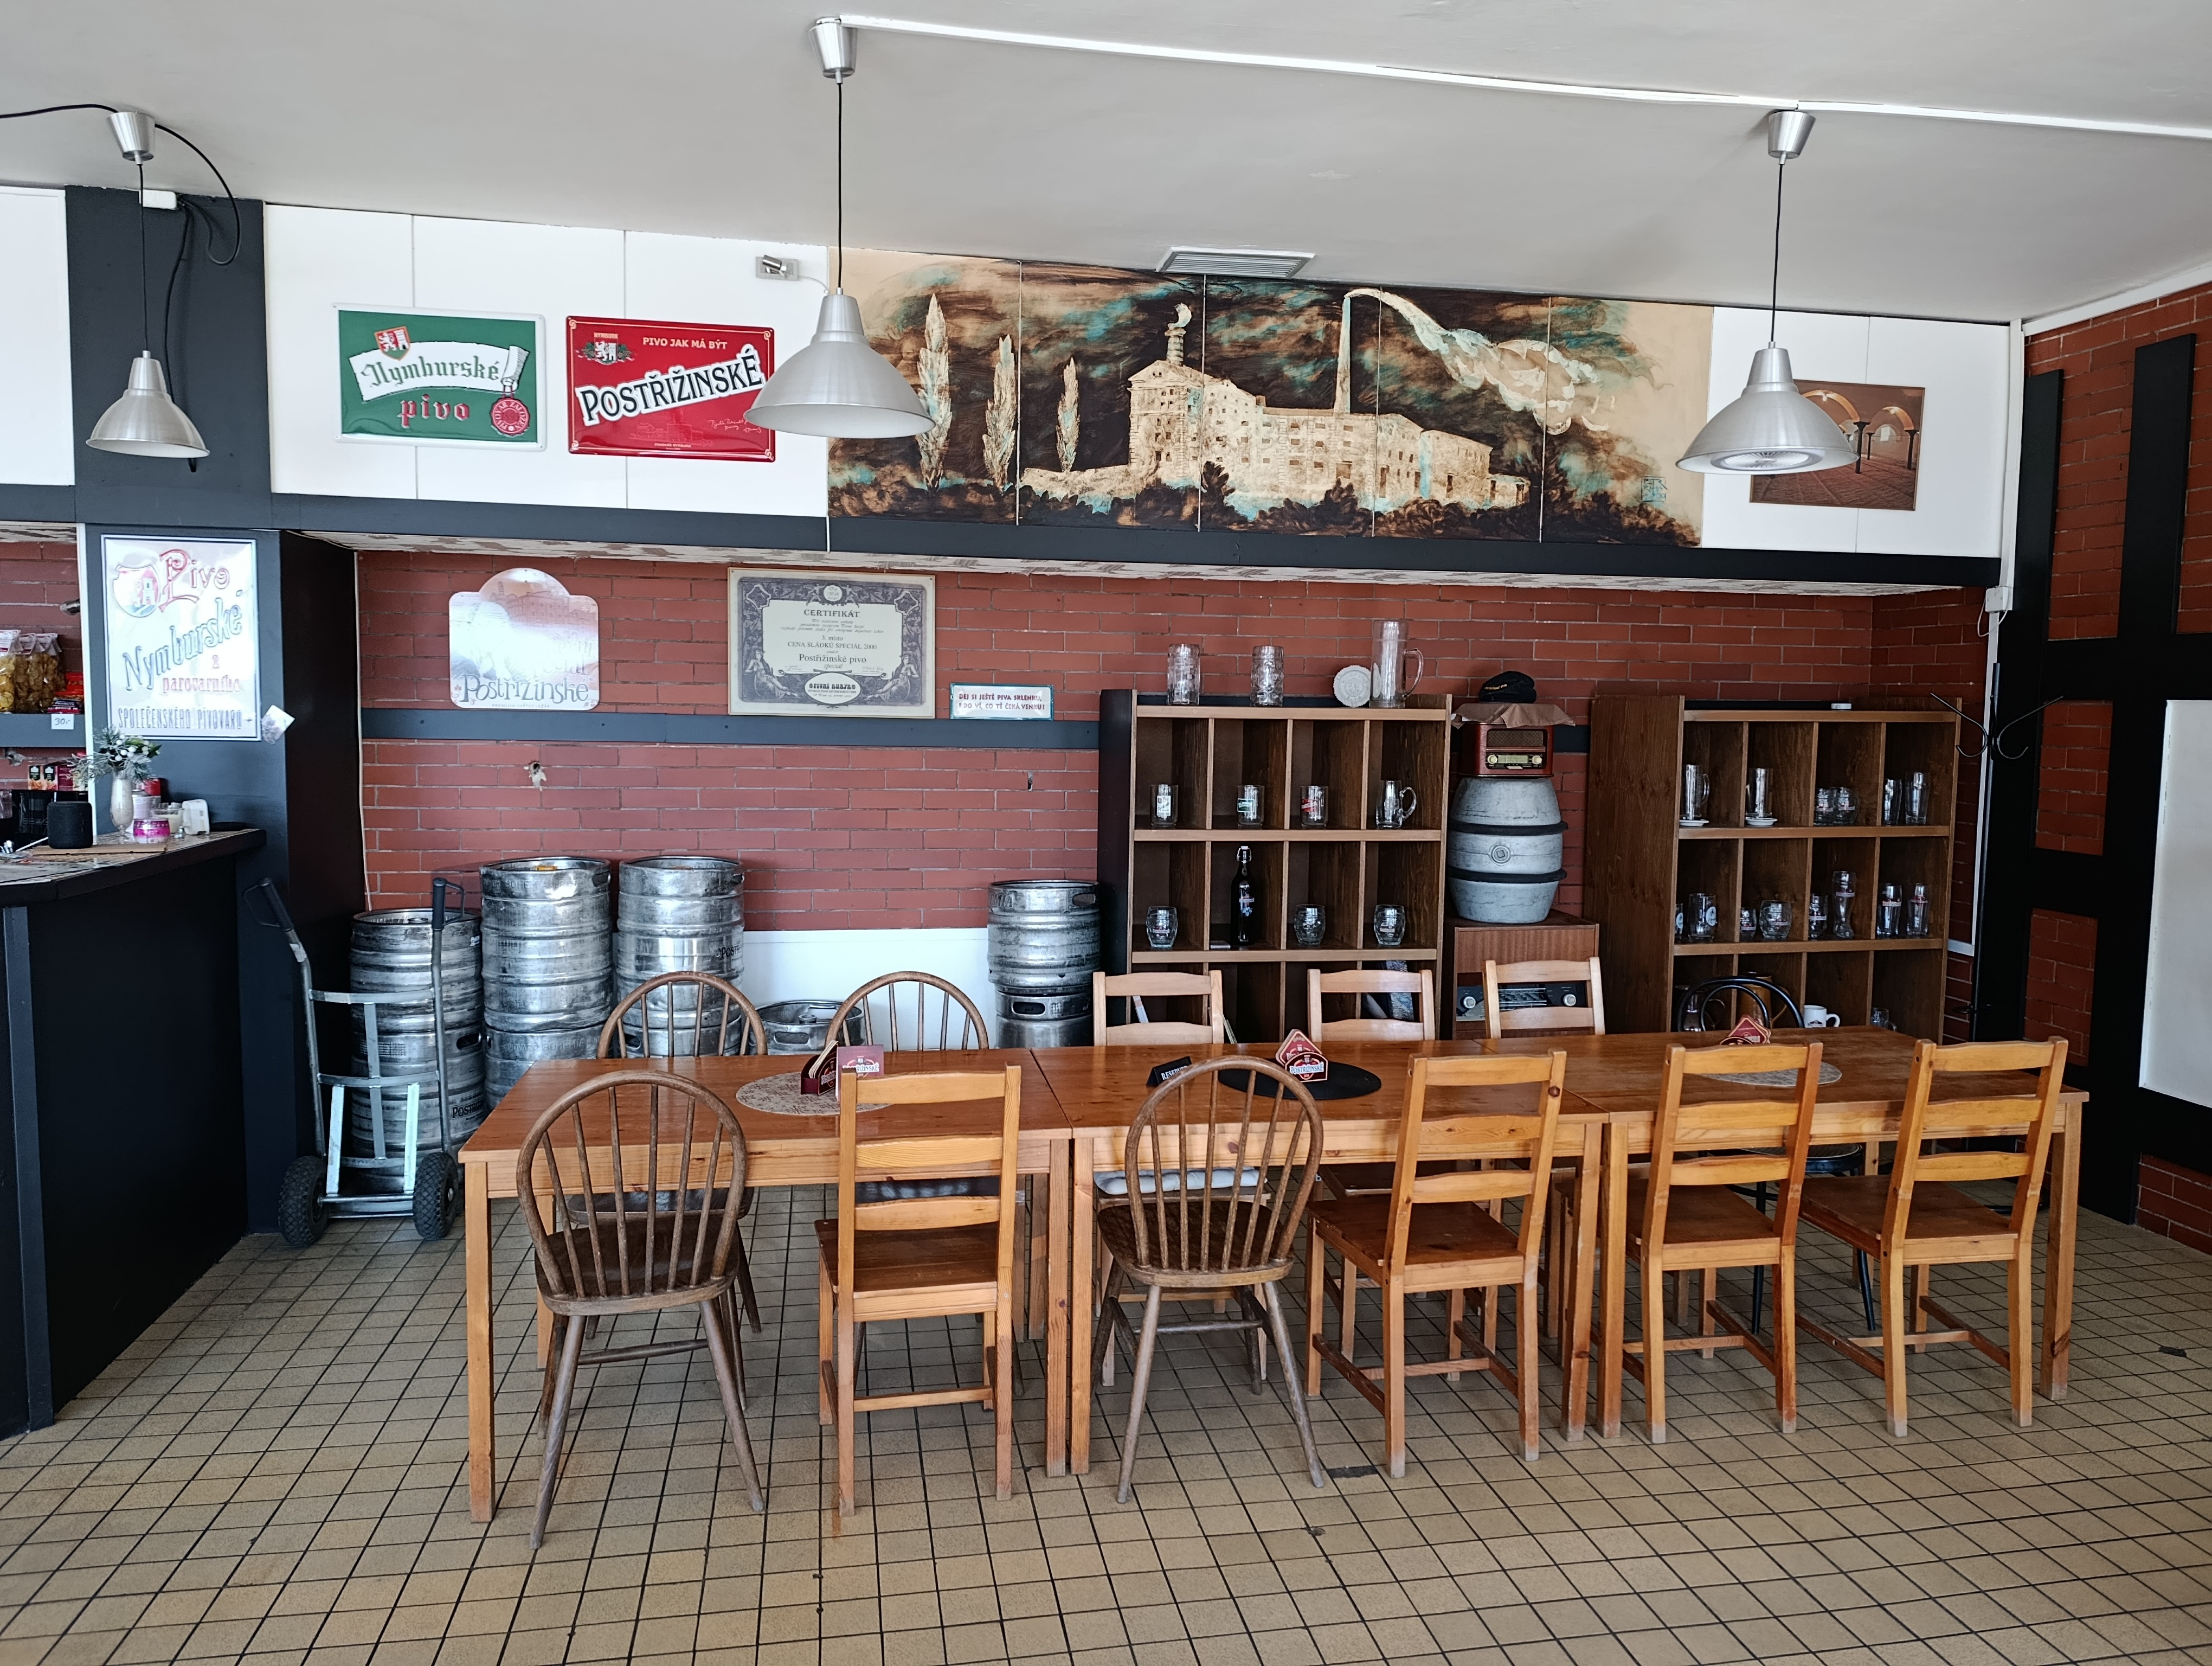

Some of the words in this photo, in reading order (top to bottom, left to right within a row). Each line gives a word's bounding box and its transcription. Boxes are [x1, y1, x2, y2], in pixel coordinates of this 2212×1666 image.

[642, 337, 668, 346] PIVO
[670, 339, 689, 348] JAK
[691, 338, 706, 349] MÁ
[708, 339, 728, 350] BÝT
[361, 355, 499, 388] Nymburské
[580, 348, 763, 422] POSTŘIŽINSKÉ
[397, 393, 470, 428] pivo
[159, 549, 230, 612] Pivo
[803, 609, 860, 618] CERTIFIKÁT
[123, 589, 243, 691] Nymburské
[799, 653, 847, 662] Postřižinské
[849, 656, 866, 664] pivo
[459, 674, 589, 704] Postřižinské
